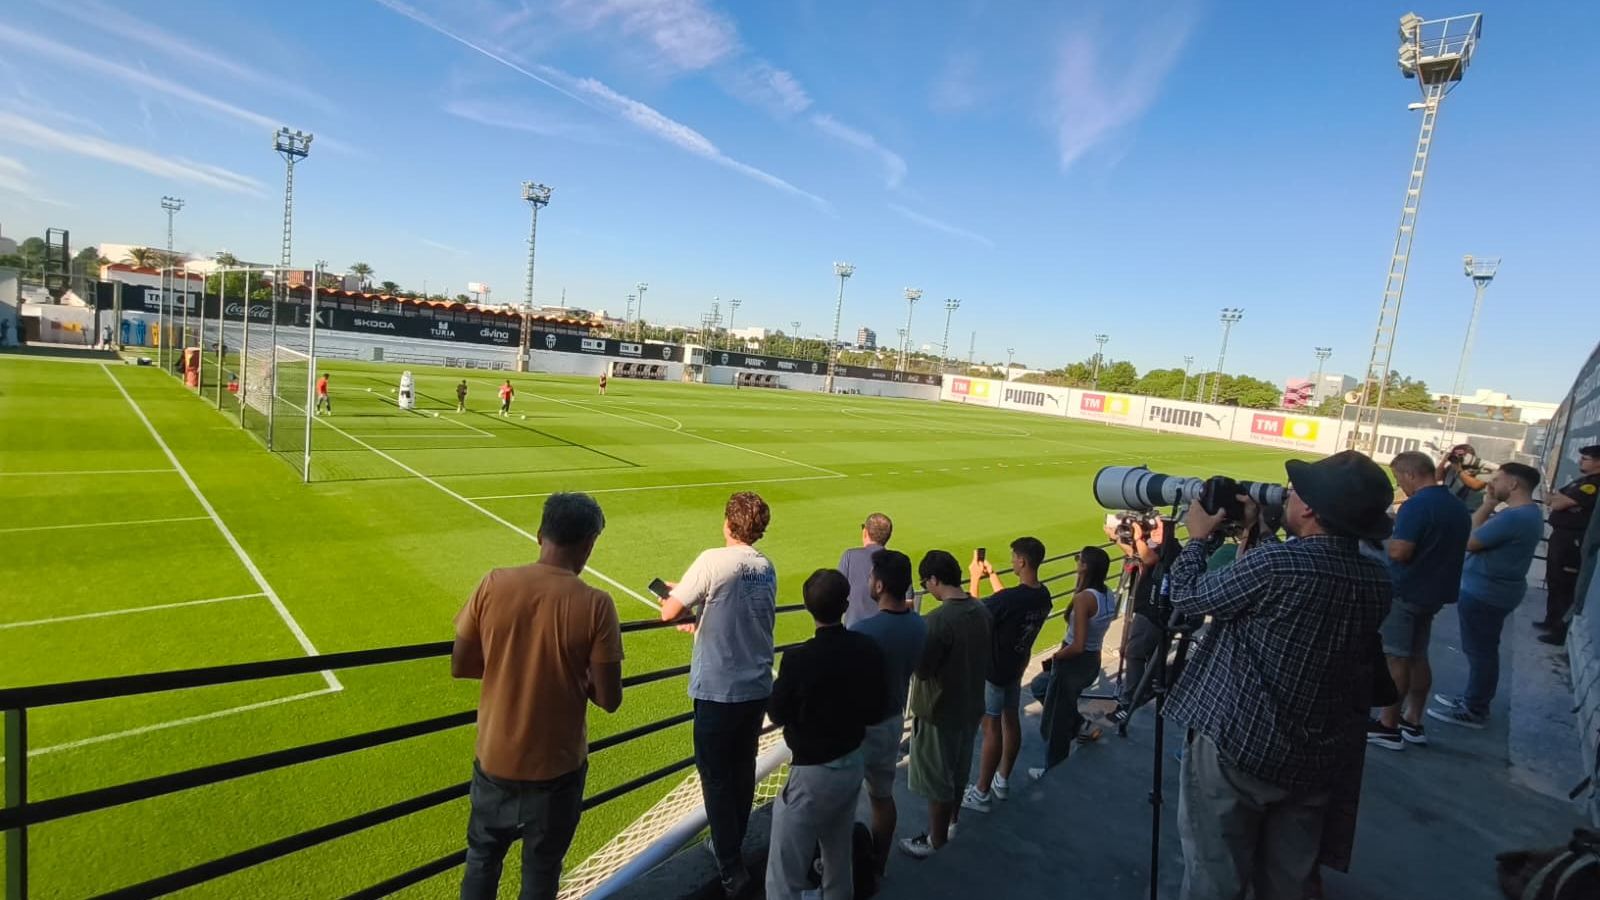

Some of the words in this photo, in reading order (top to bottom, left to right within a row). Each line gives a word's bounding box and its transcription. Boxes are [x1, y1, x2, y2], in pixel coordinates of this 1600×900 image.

[225, 302, 272, 318] CocaCola
[431, 328, 455, 337] TURIA
[480, 328, 509, 339] divina
[954, 381, 968, 392] TM
[1005, 388, 1045, 407] PUMA
[1084, 397, 1100, 408] TM
[1149, 405, 1203, 428] PUMA
[1255, 419, 1278, 432] TM
